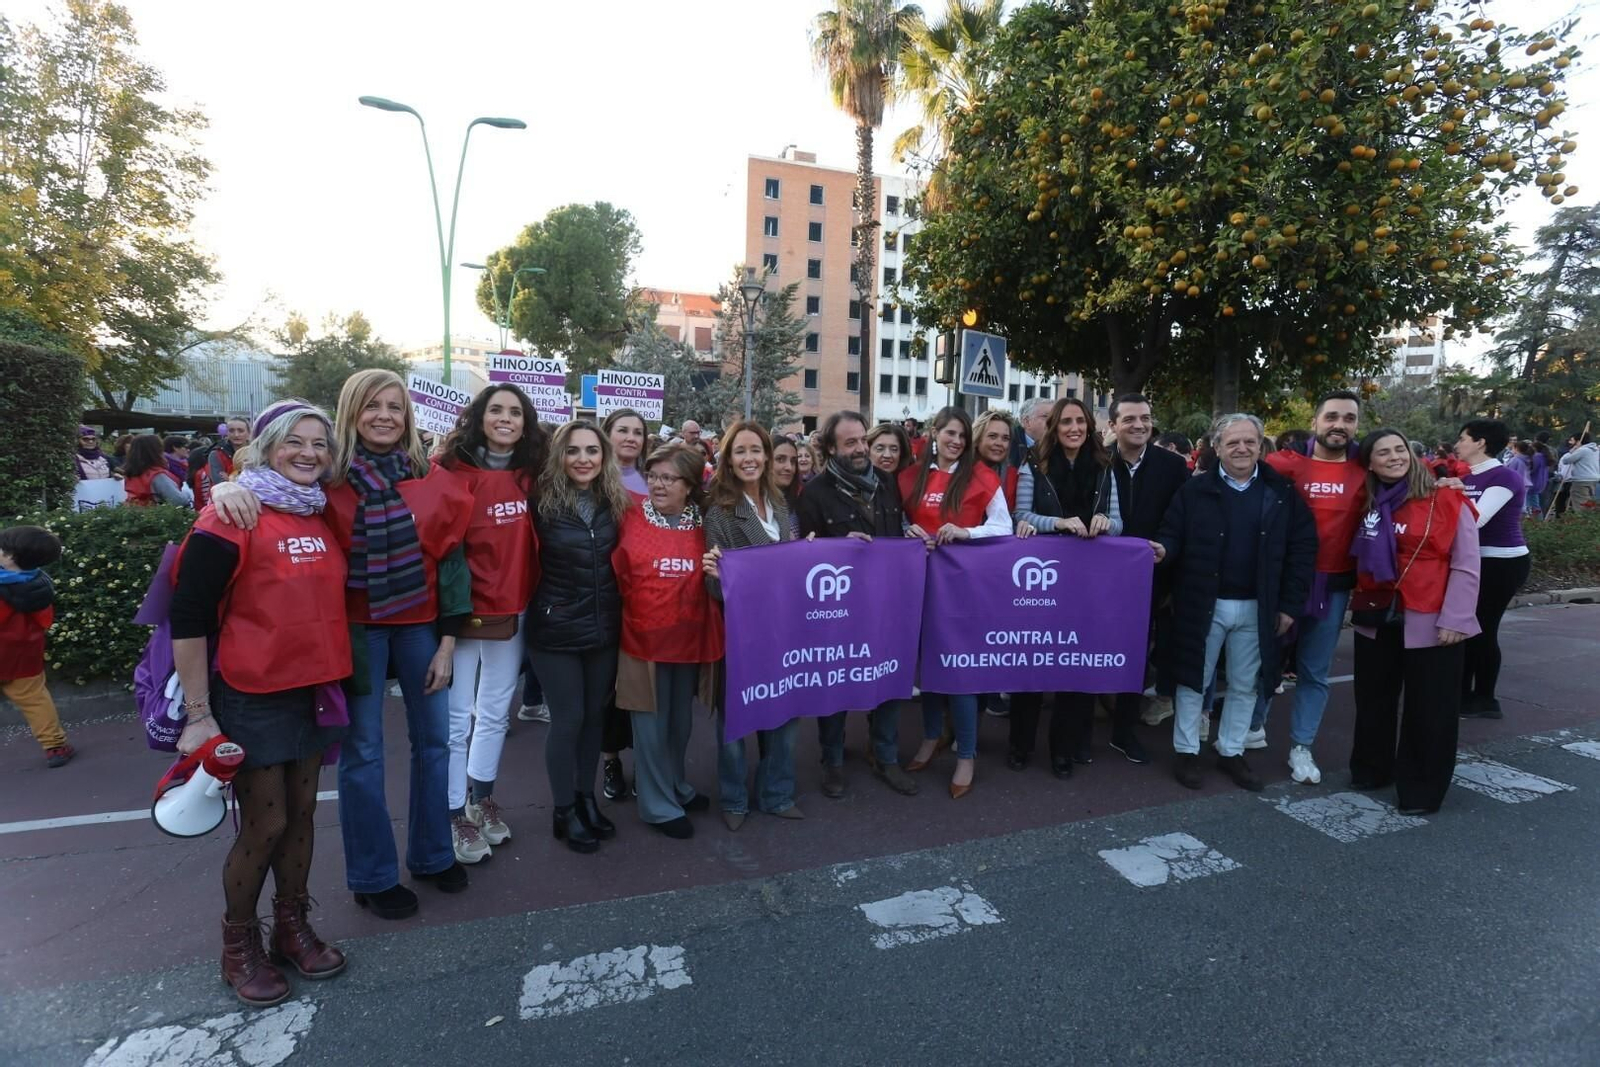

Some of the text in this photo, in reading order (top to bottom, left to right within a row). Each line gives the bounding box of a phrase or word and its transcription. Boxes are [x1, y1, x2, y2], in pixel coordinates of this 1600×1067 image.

[493, 357, 562, 373] HINOJOSA
[508, 373, 546, 384] CONTRA
[601, 372, 661, 388] HINOJOSA
[412, 377, 471, 406] HINOJOSA
[520, 385, 562, 396] OLENCIA
[615, 387, 647, 397] CONTRA
[425, 397, 457, 414] CONTRA
[600, 397, 661, 409] LA VIOLENCIA
[423, 407, 456, 425] VIOLEN
[1303, 482, 1344, 494] #25N
[487, 500, 527, 517] #25N
[277, 536, 327, 554] #25N
[653, 557, 694, 572] #25N
[1013, 597, 1057, 607] CÓRDOBA
[806, 608, 849, 620] CÓRDOBA
[985, 630, 1079, 645] CONTRA LA
[782, 643, 871, 668] CONTRA LA
[940, 652, 1126, 668] VIOLENCIA DE GENERO
[741, 658, 899, 705] VIOLENCIA DE GENERO
